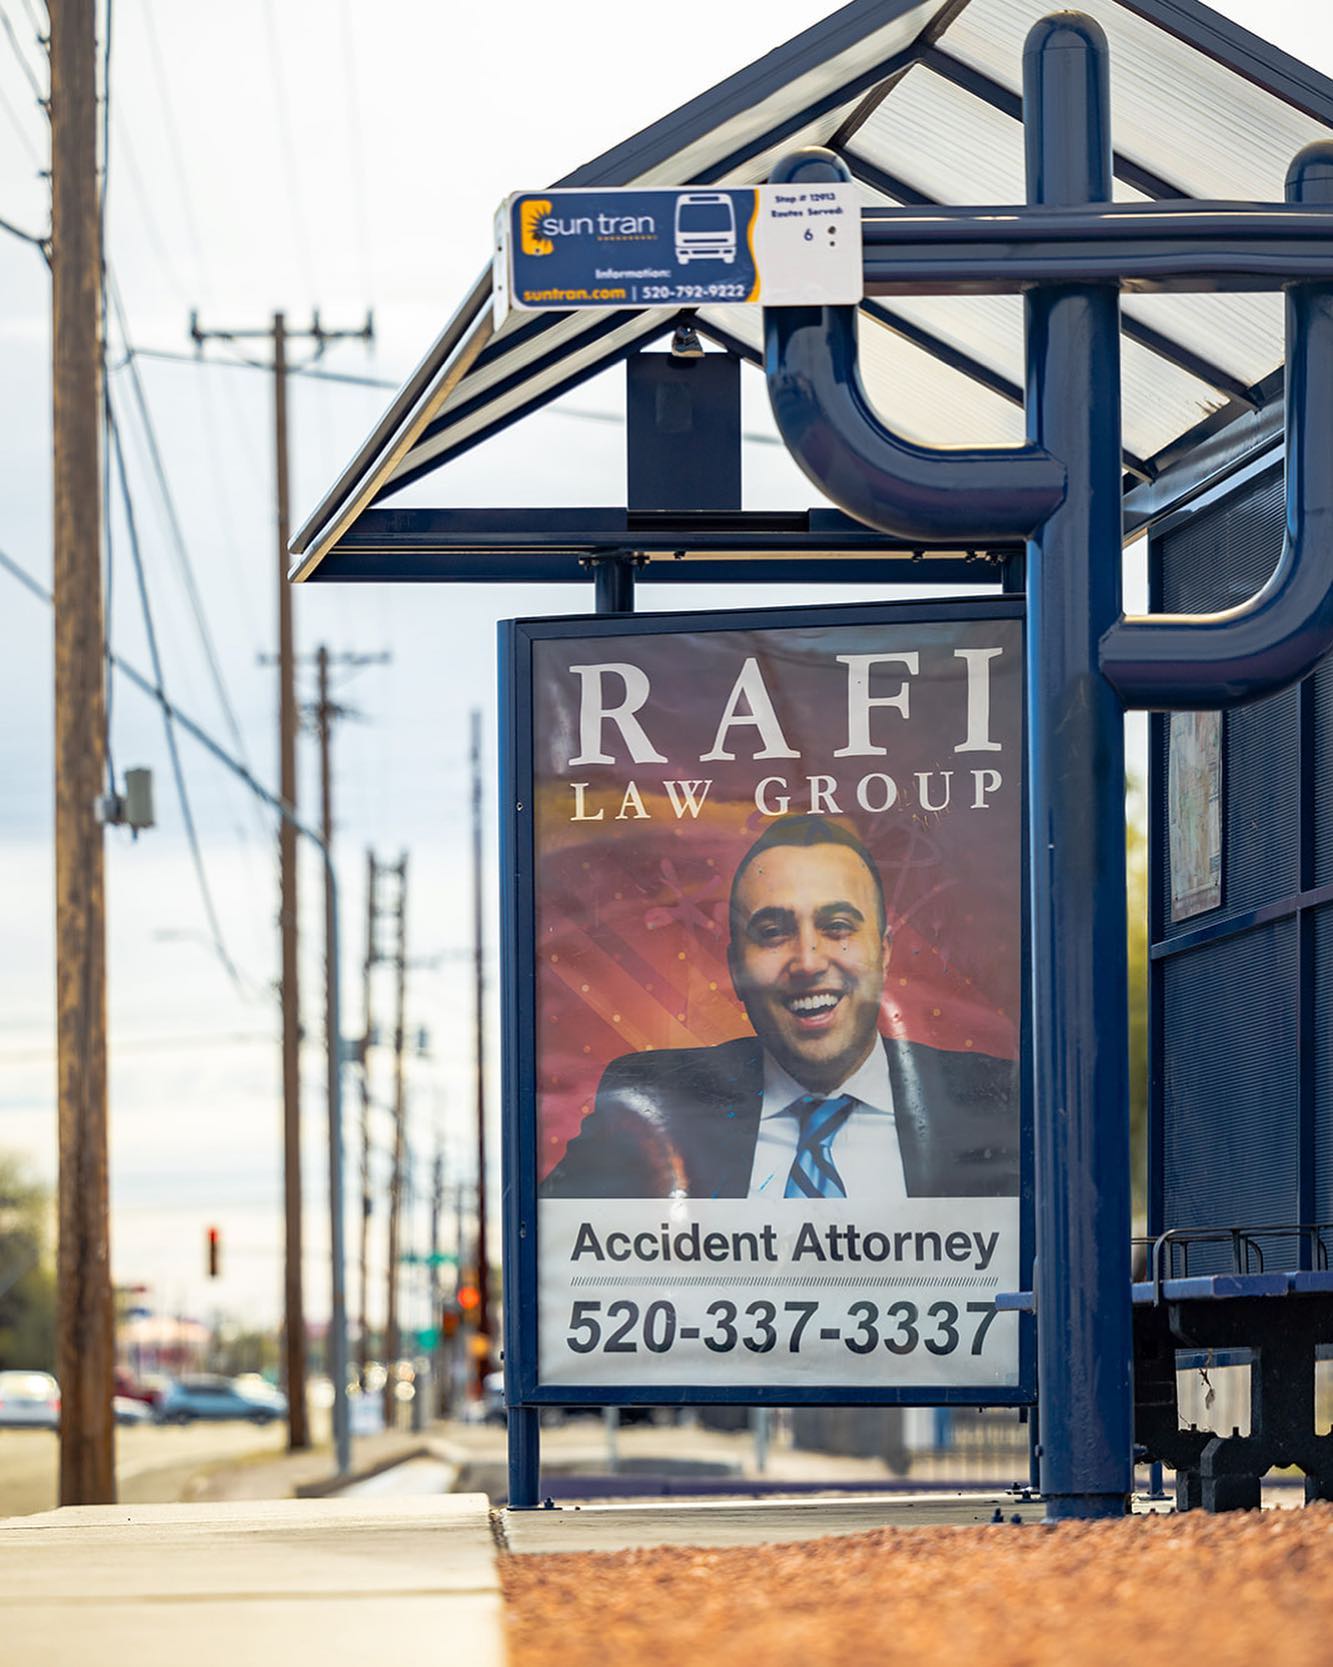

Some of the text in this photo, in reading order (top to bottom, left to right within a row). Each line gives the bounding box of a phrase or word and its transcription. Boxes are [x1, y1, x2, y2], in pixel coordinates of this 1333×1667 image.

[775, 195, 796, 204] Stop
[542, 212, 656, 236] sun tran
[771, 210, 803, 218] Routes
[804, 228, 813, 241] 6
[595, 267, 671, 280] Information:
[523, 285, 745, 301] suntran.com 520-792-9222
[568, 647, 1003, 766] RAFI
[569, 769, 1003, 822] LAW GROUP
[570, 1222, 1000, 1270] Accident Attorney
[566, 1300, 1000, 1356] 520-337-3337
